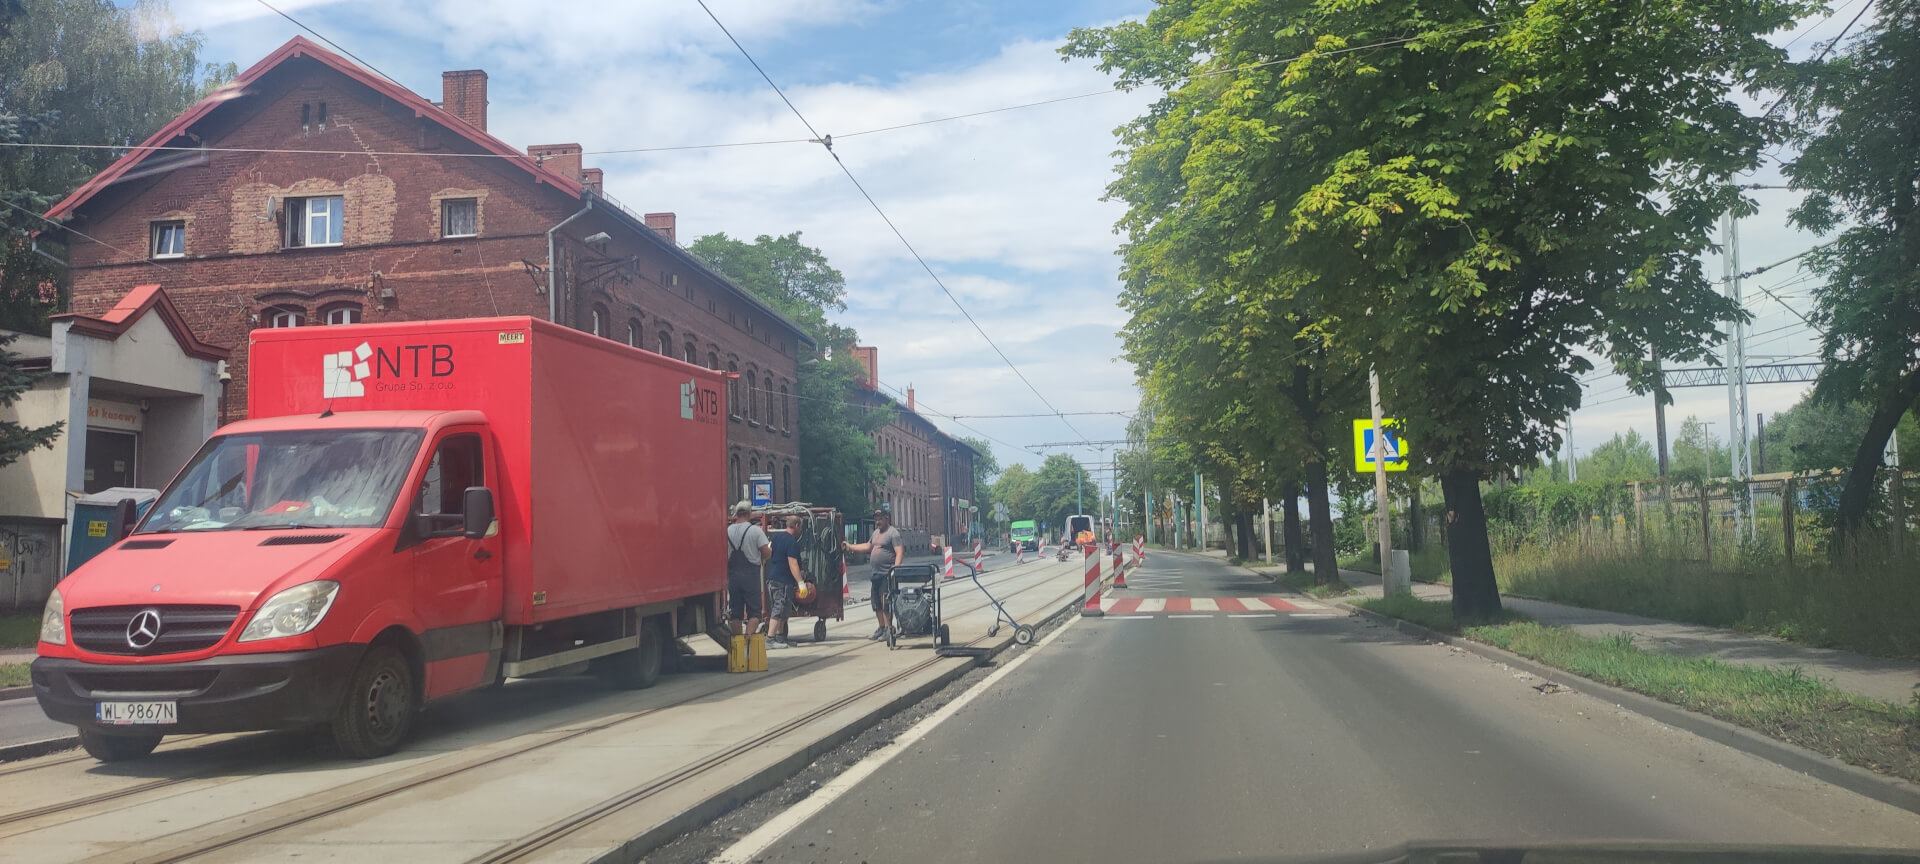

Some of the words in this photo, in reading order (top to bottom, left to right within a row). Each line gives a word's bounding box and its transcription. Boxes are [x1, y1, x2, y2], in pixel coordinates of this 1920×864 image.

[499, 333, 523, 341] MEERT
[376, 344, 455, 379] NTB
[375, 382, 406, 392] Grupa
[409, 381, 425, 391] Sp.
[695, 387, 718, 415] NTB
[102, 408, 136, 424] kasowy
[104, 703, 121, 719] WL
[127, 703, 173, 719] 9867N
